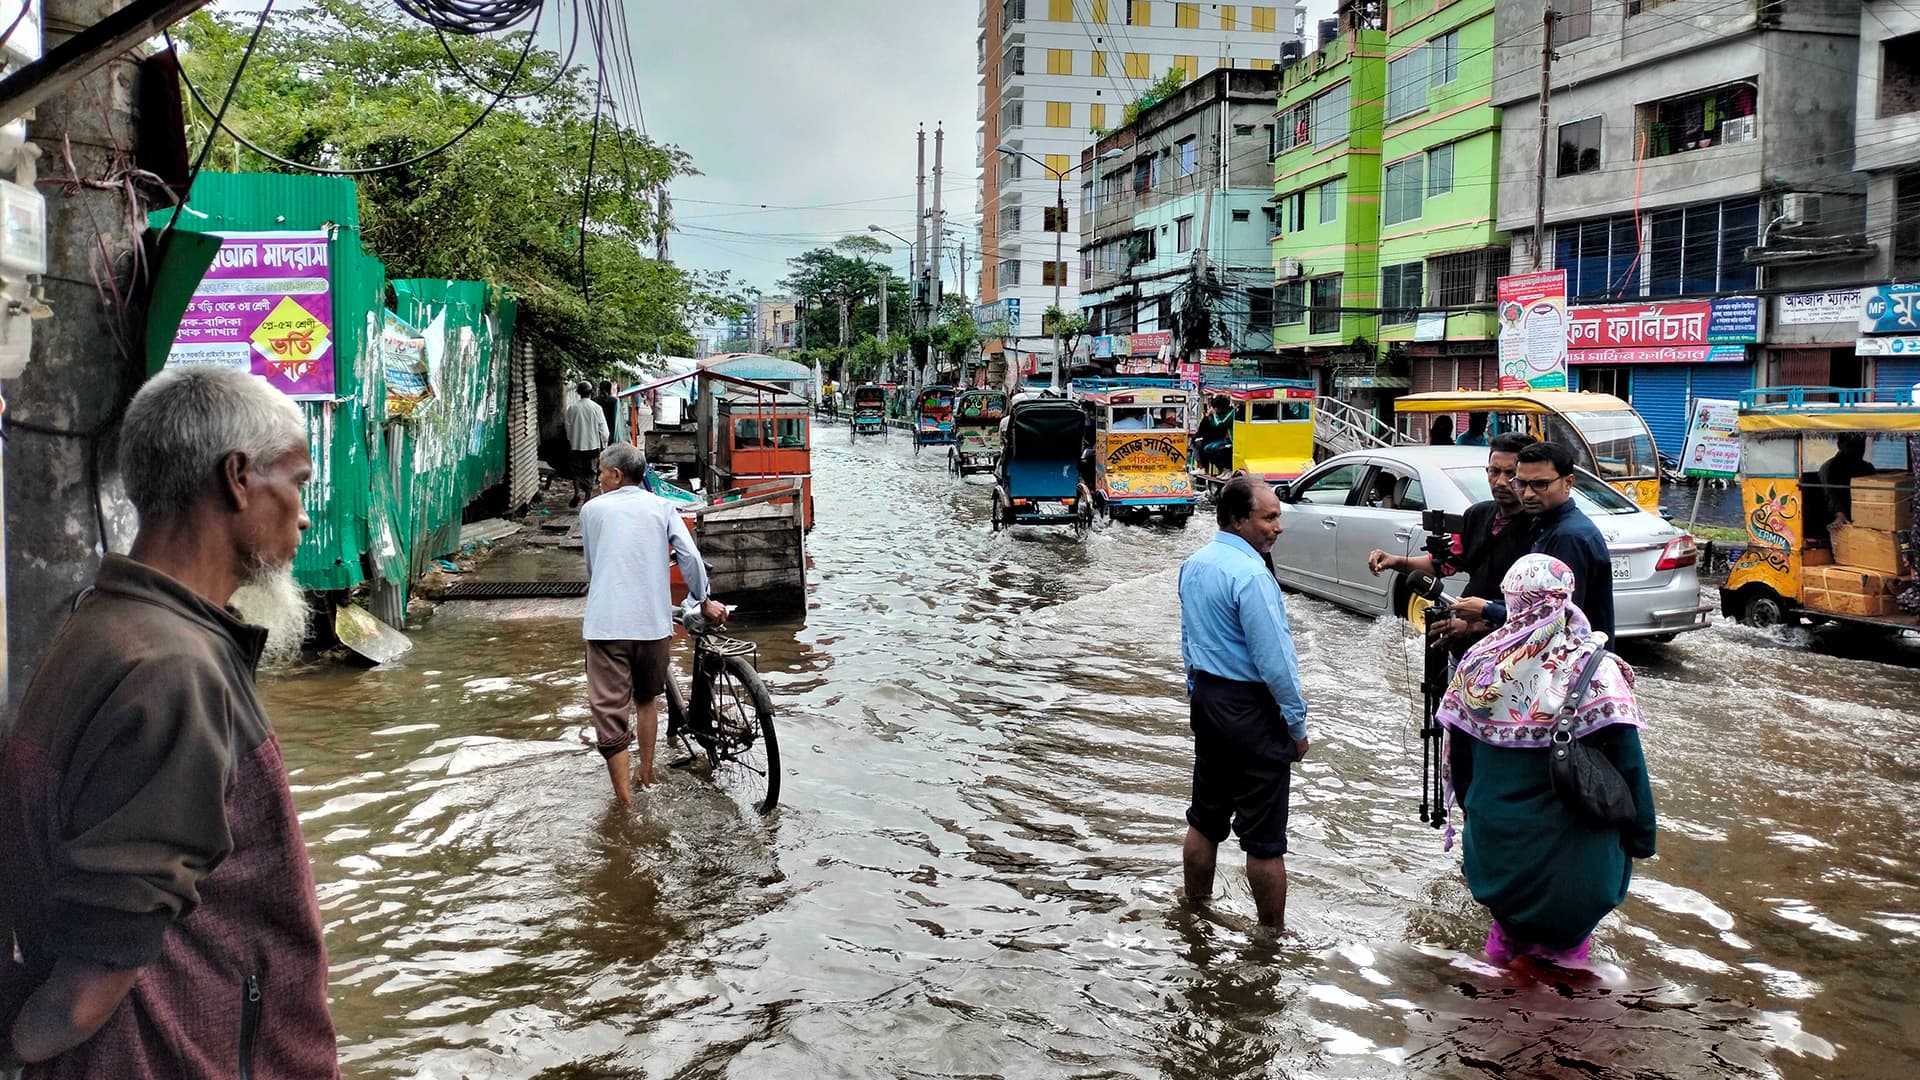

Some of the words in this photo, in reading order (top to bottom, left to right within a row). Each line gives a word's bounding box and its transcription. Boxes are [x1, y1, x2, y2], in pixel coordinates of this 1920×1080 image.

[263, 243, 328, 271] মাদরাসা
[1784, 294, 1825, 308] আমজাদ
[1868, 302, 1886, 314] MF
[1888, 291, 1920, 329] মু
[1606, 305, 1706, 343] ফার্নিচার
[268, 329, 315, 357] ভর্তি
